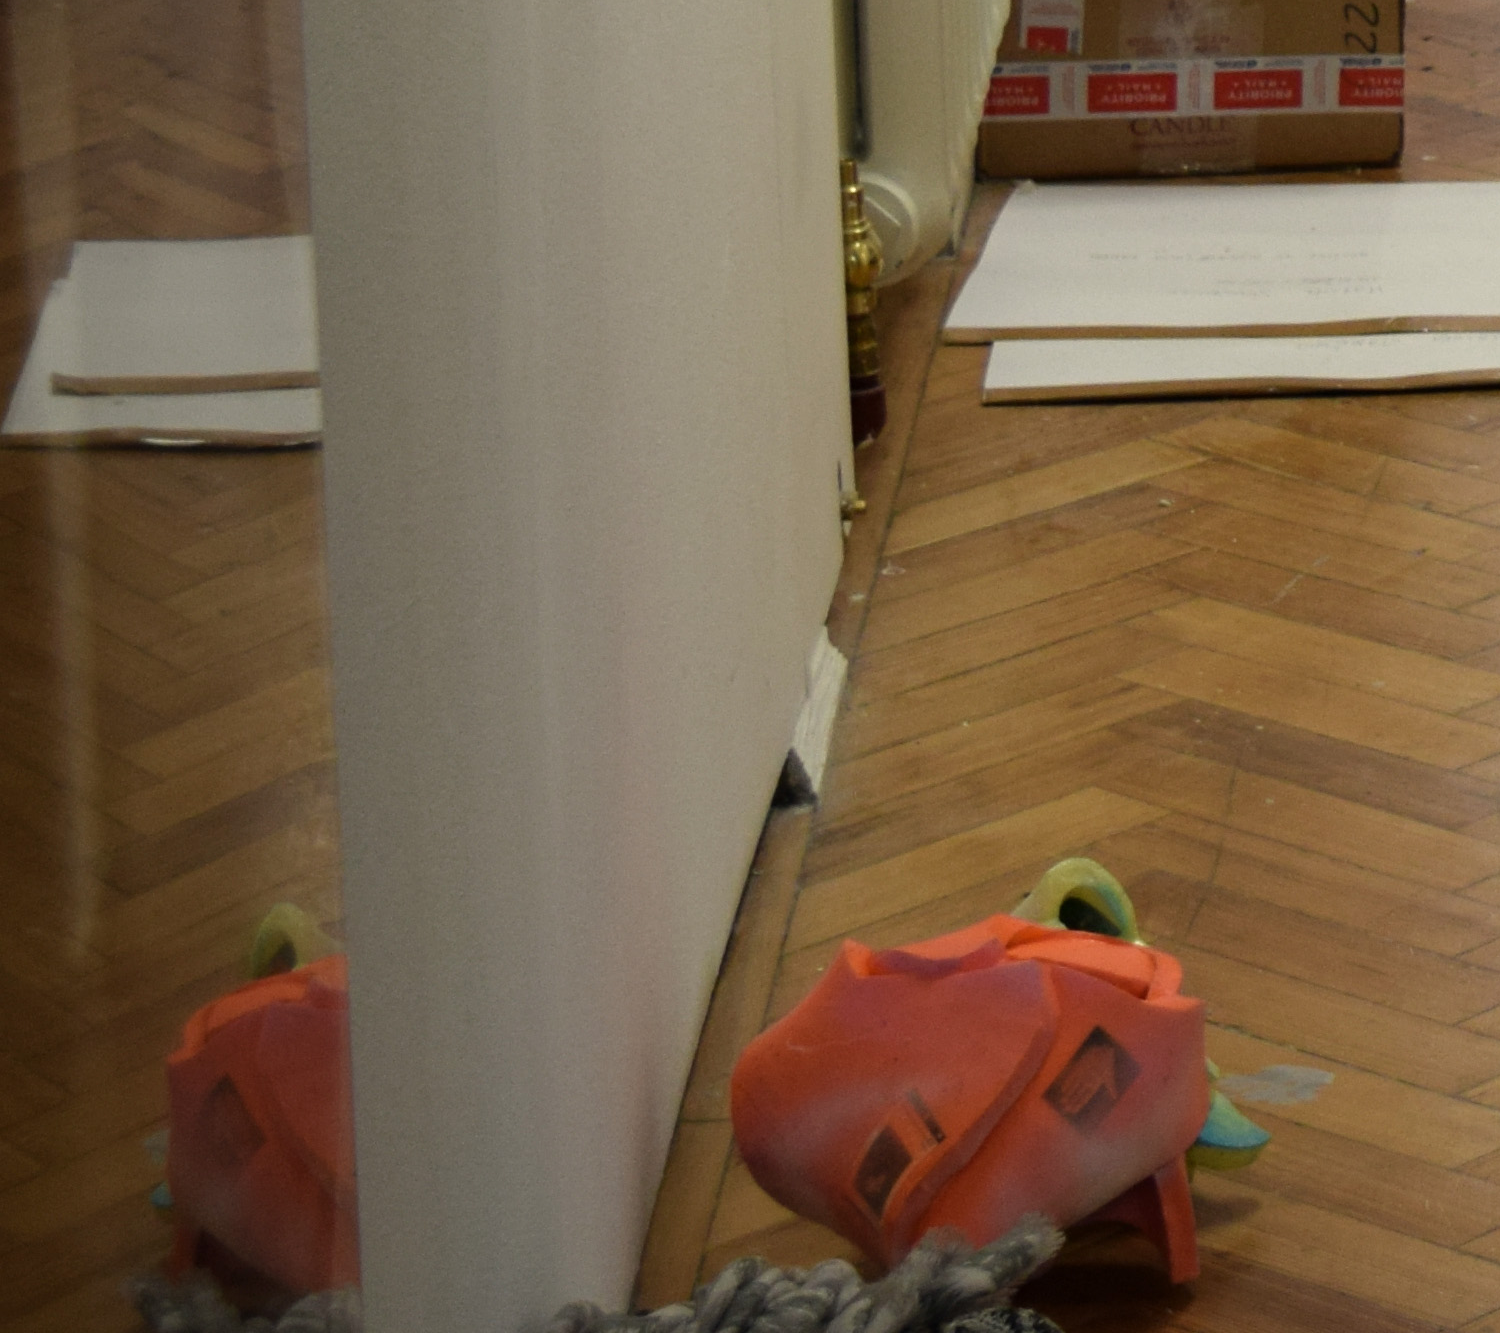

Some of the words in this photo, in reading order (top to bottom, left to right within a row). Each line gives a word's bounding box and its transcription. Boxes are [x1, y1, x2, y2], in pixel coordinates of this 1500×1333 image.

[1117, 82, 1151, 92] MAIL
[1244, 78, 1273, 88] MAIL
[1227, 89, 1293, 100] PRIORITY
[1353, 87, 1402, 98] IORITY
[986, 96, 1039, 106] PRIORI
[1101, 93, 1167, 104] PRIORITY
